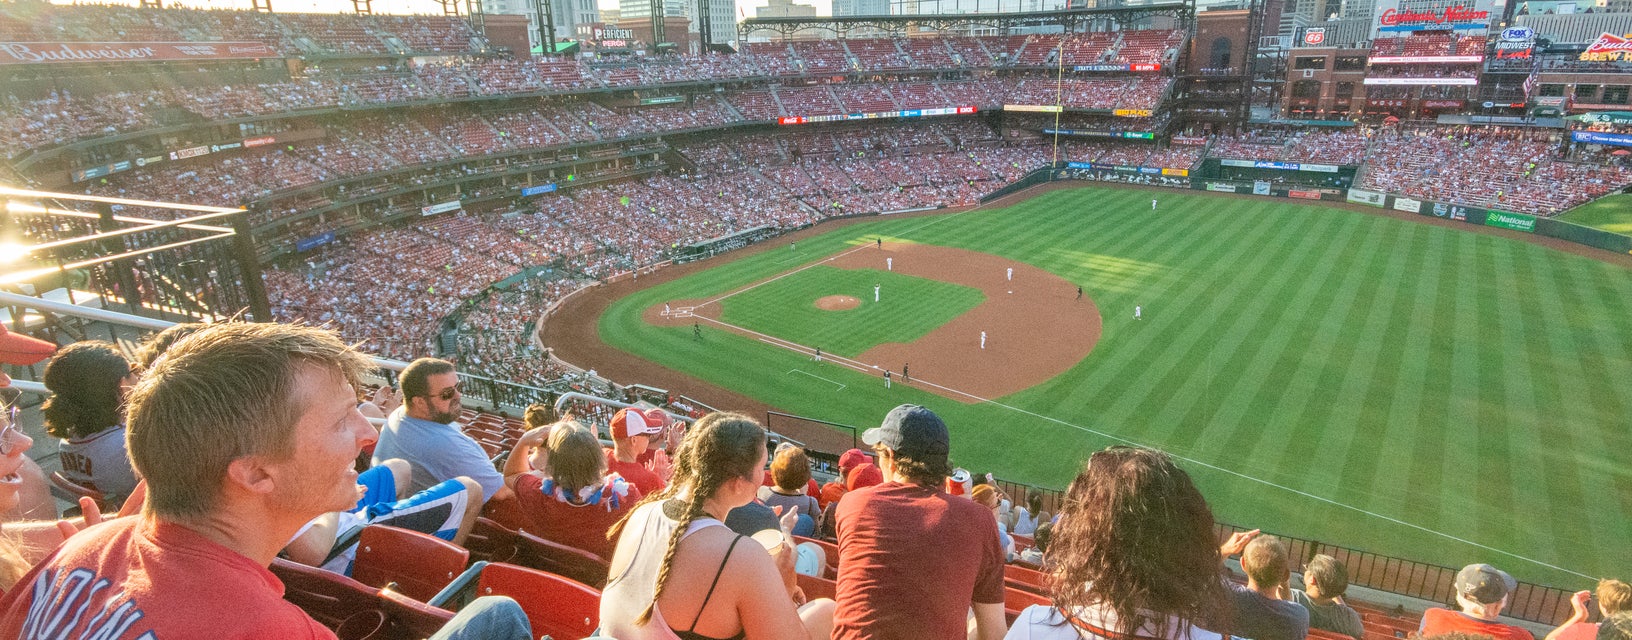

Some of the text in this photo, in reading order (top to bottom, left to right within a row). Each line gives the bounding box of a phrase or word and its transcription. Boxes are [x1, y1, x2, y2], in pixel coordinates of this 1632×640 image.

[1436, 6, 1488, 24] Nation
[1307, 33, 1321, 41] 66
[1508, 29, 1527, 37] FOX
[1495, 41, 1536, 50] MIDWEST
[0, 43, 154, 62] Budweiser
[1579, 52, 1622, 62] BREW
[1497, 215, 1534, 227] National
